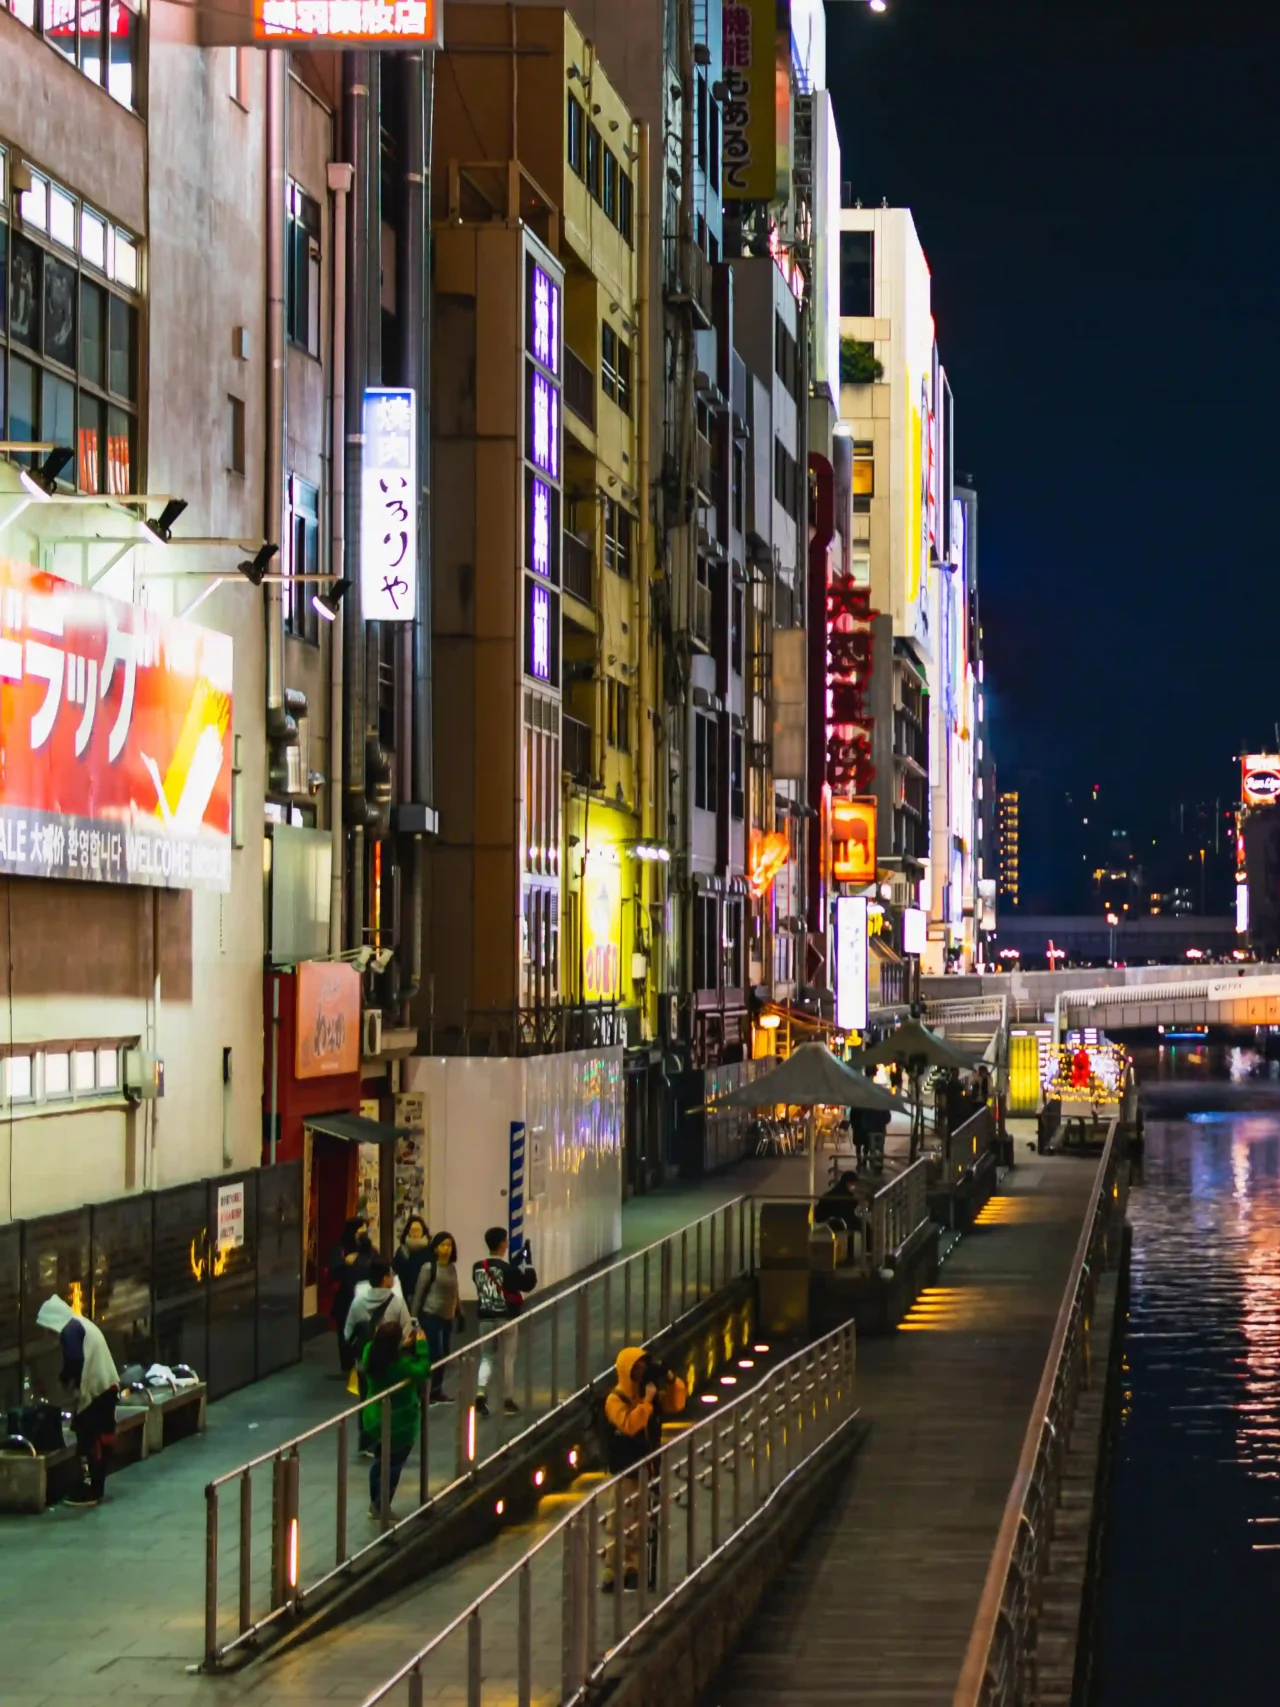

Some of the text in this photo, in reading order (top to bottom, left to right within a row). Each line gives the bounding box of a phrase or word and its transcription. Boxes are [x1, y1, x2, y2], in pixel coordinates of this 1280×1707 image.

[380, 476, 409, 610] いろりや
[68, 827, 122, 871] 환영합니다
[125, 830, 192, 877] WELCOME
